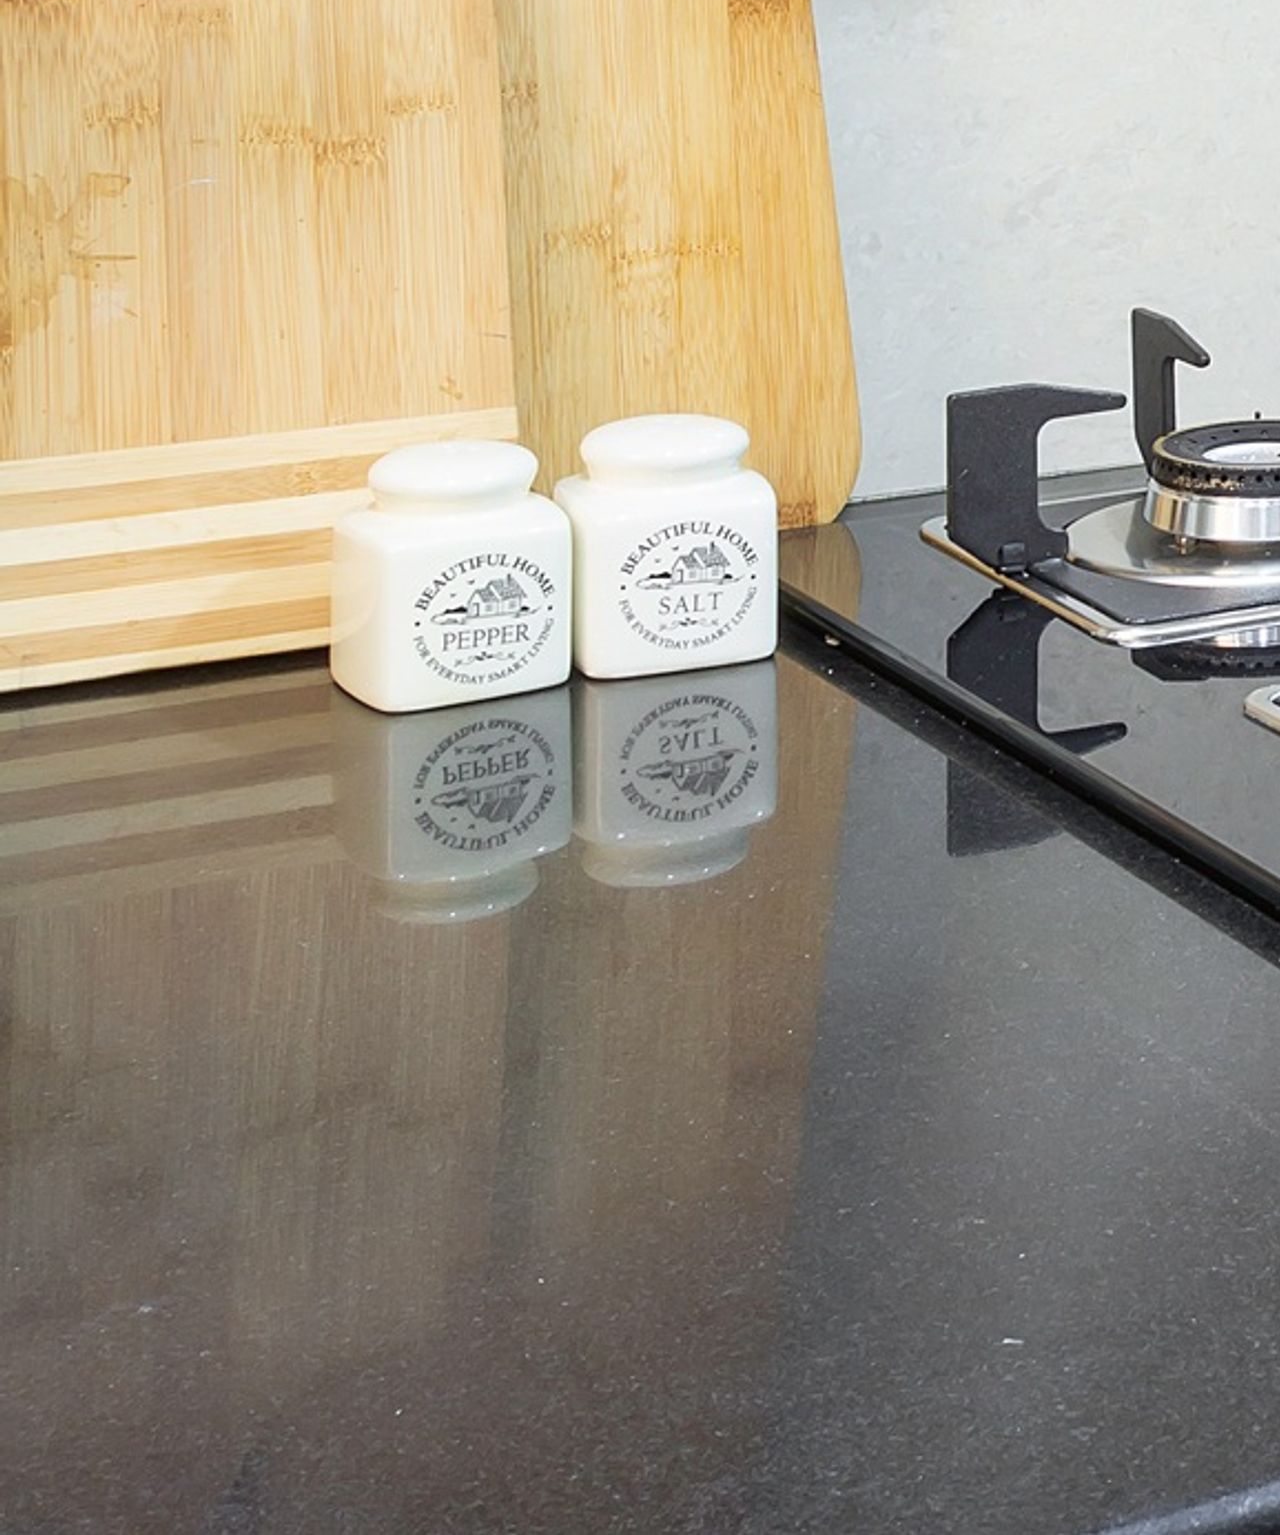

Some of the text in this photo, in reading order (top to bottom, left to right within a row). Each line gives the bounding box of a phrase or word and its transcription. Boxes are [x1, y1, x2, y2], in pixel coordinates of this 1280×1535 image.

[620, 521, 760, 575] BEAUTIFUL HOME
[414, 553, 556, 611] BEAUTIFUL HOME
[658, 591, 723, 615] SALT
[442, 623, 530, 651] PEPPER
[618, 586, 758, 650] FOR EVERYDAY SMART LIVING
[413, 617, 555, 685] FOR EVERYDAY SMART LIVING
